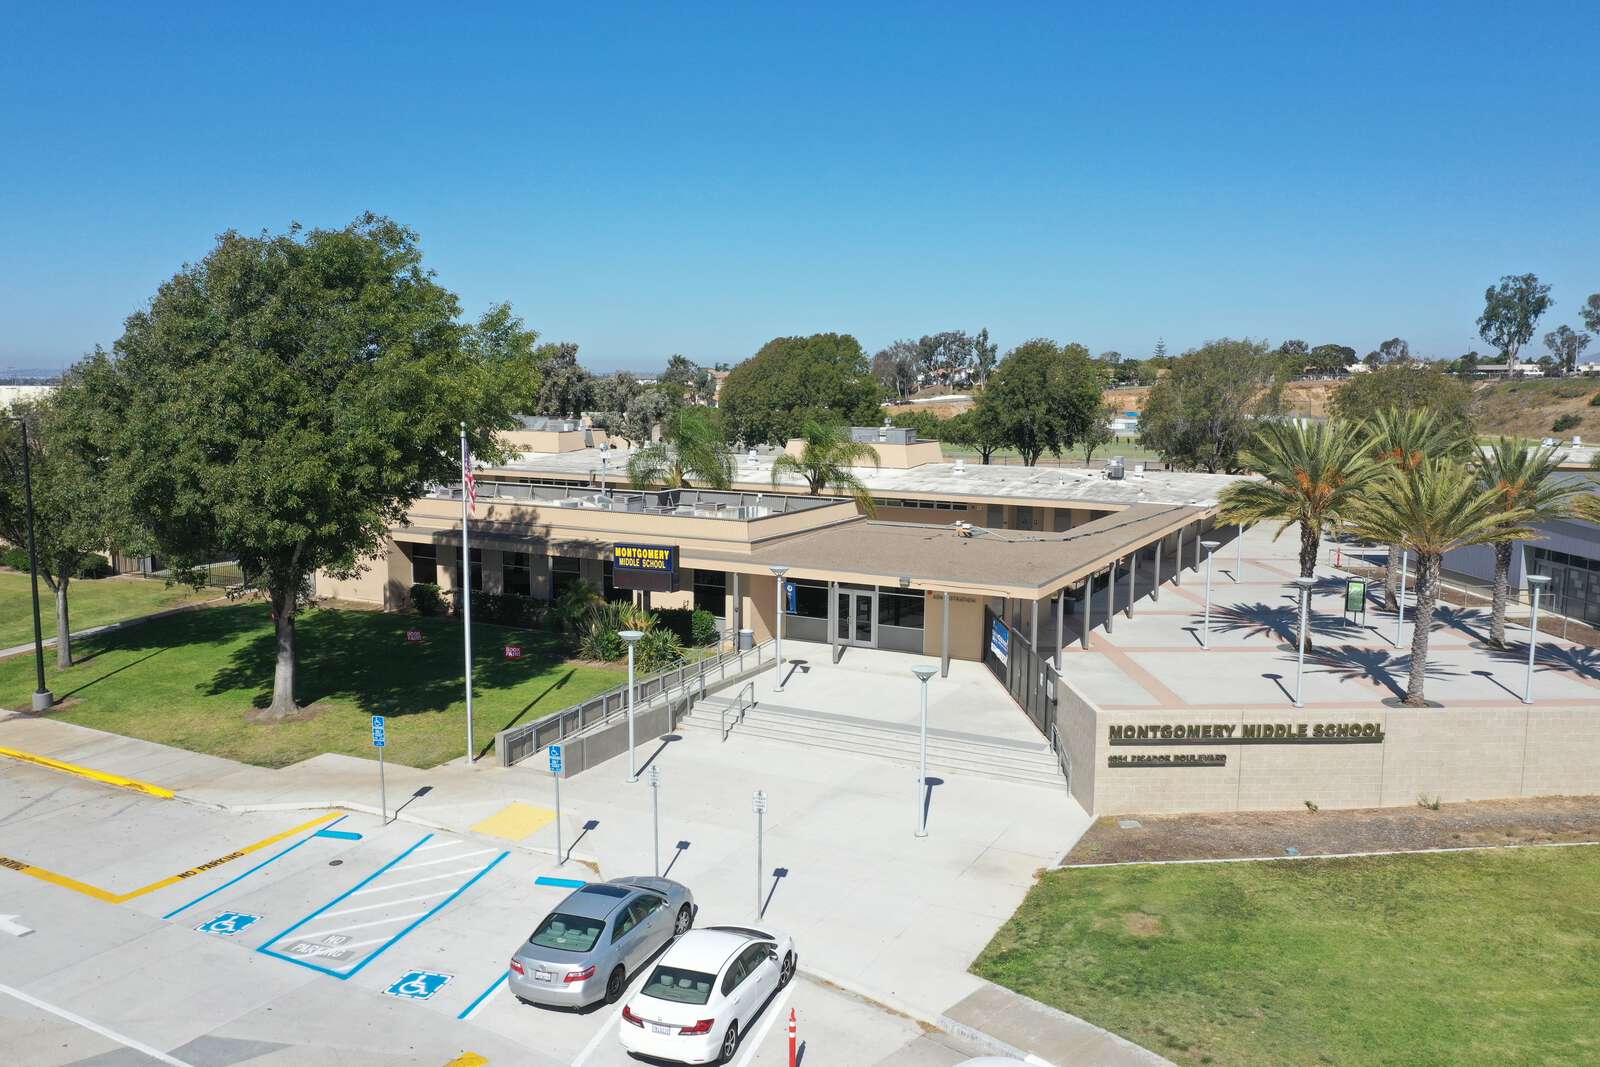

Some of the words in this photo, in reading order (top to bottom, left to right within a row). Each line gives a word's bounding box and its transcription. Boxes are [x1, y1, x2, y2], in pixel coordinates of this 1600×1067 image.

[615, 547, 669, 560] MONTGOMERY
[619, 558, 640, 567] MIDDLE
[642, 559, 666, 568] SCHOOL
[1109, 724, 1235, 738] MONTGOMERY
[1242, 723, 1308, 738] MIDDLE
[1313, 722, 1385, 737] SCHOOL
[177, 870, 197, 879] NO
[196, 851, 245, 872] PARKING
[323, 935, 347, 945] NO
